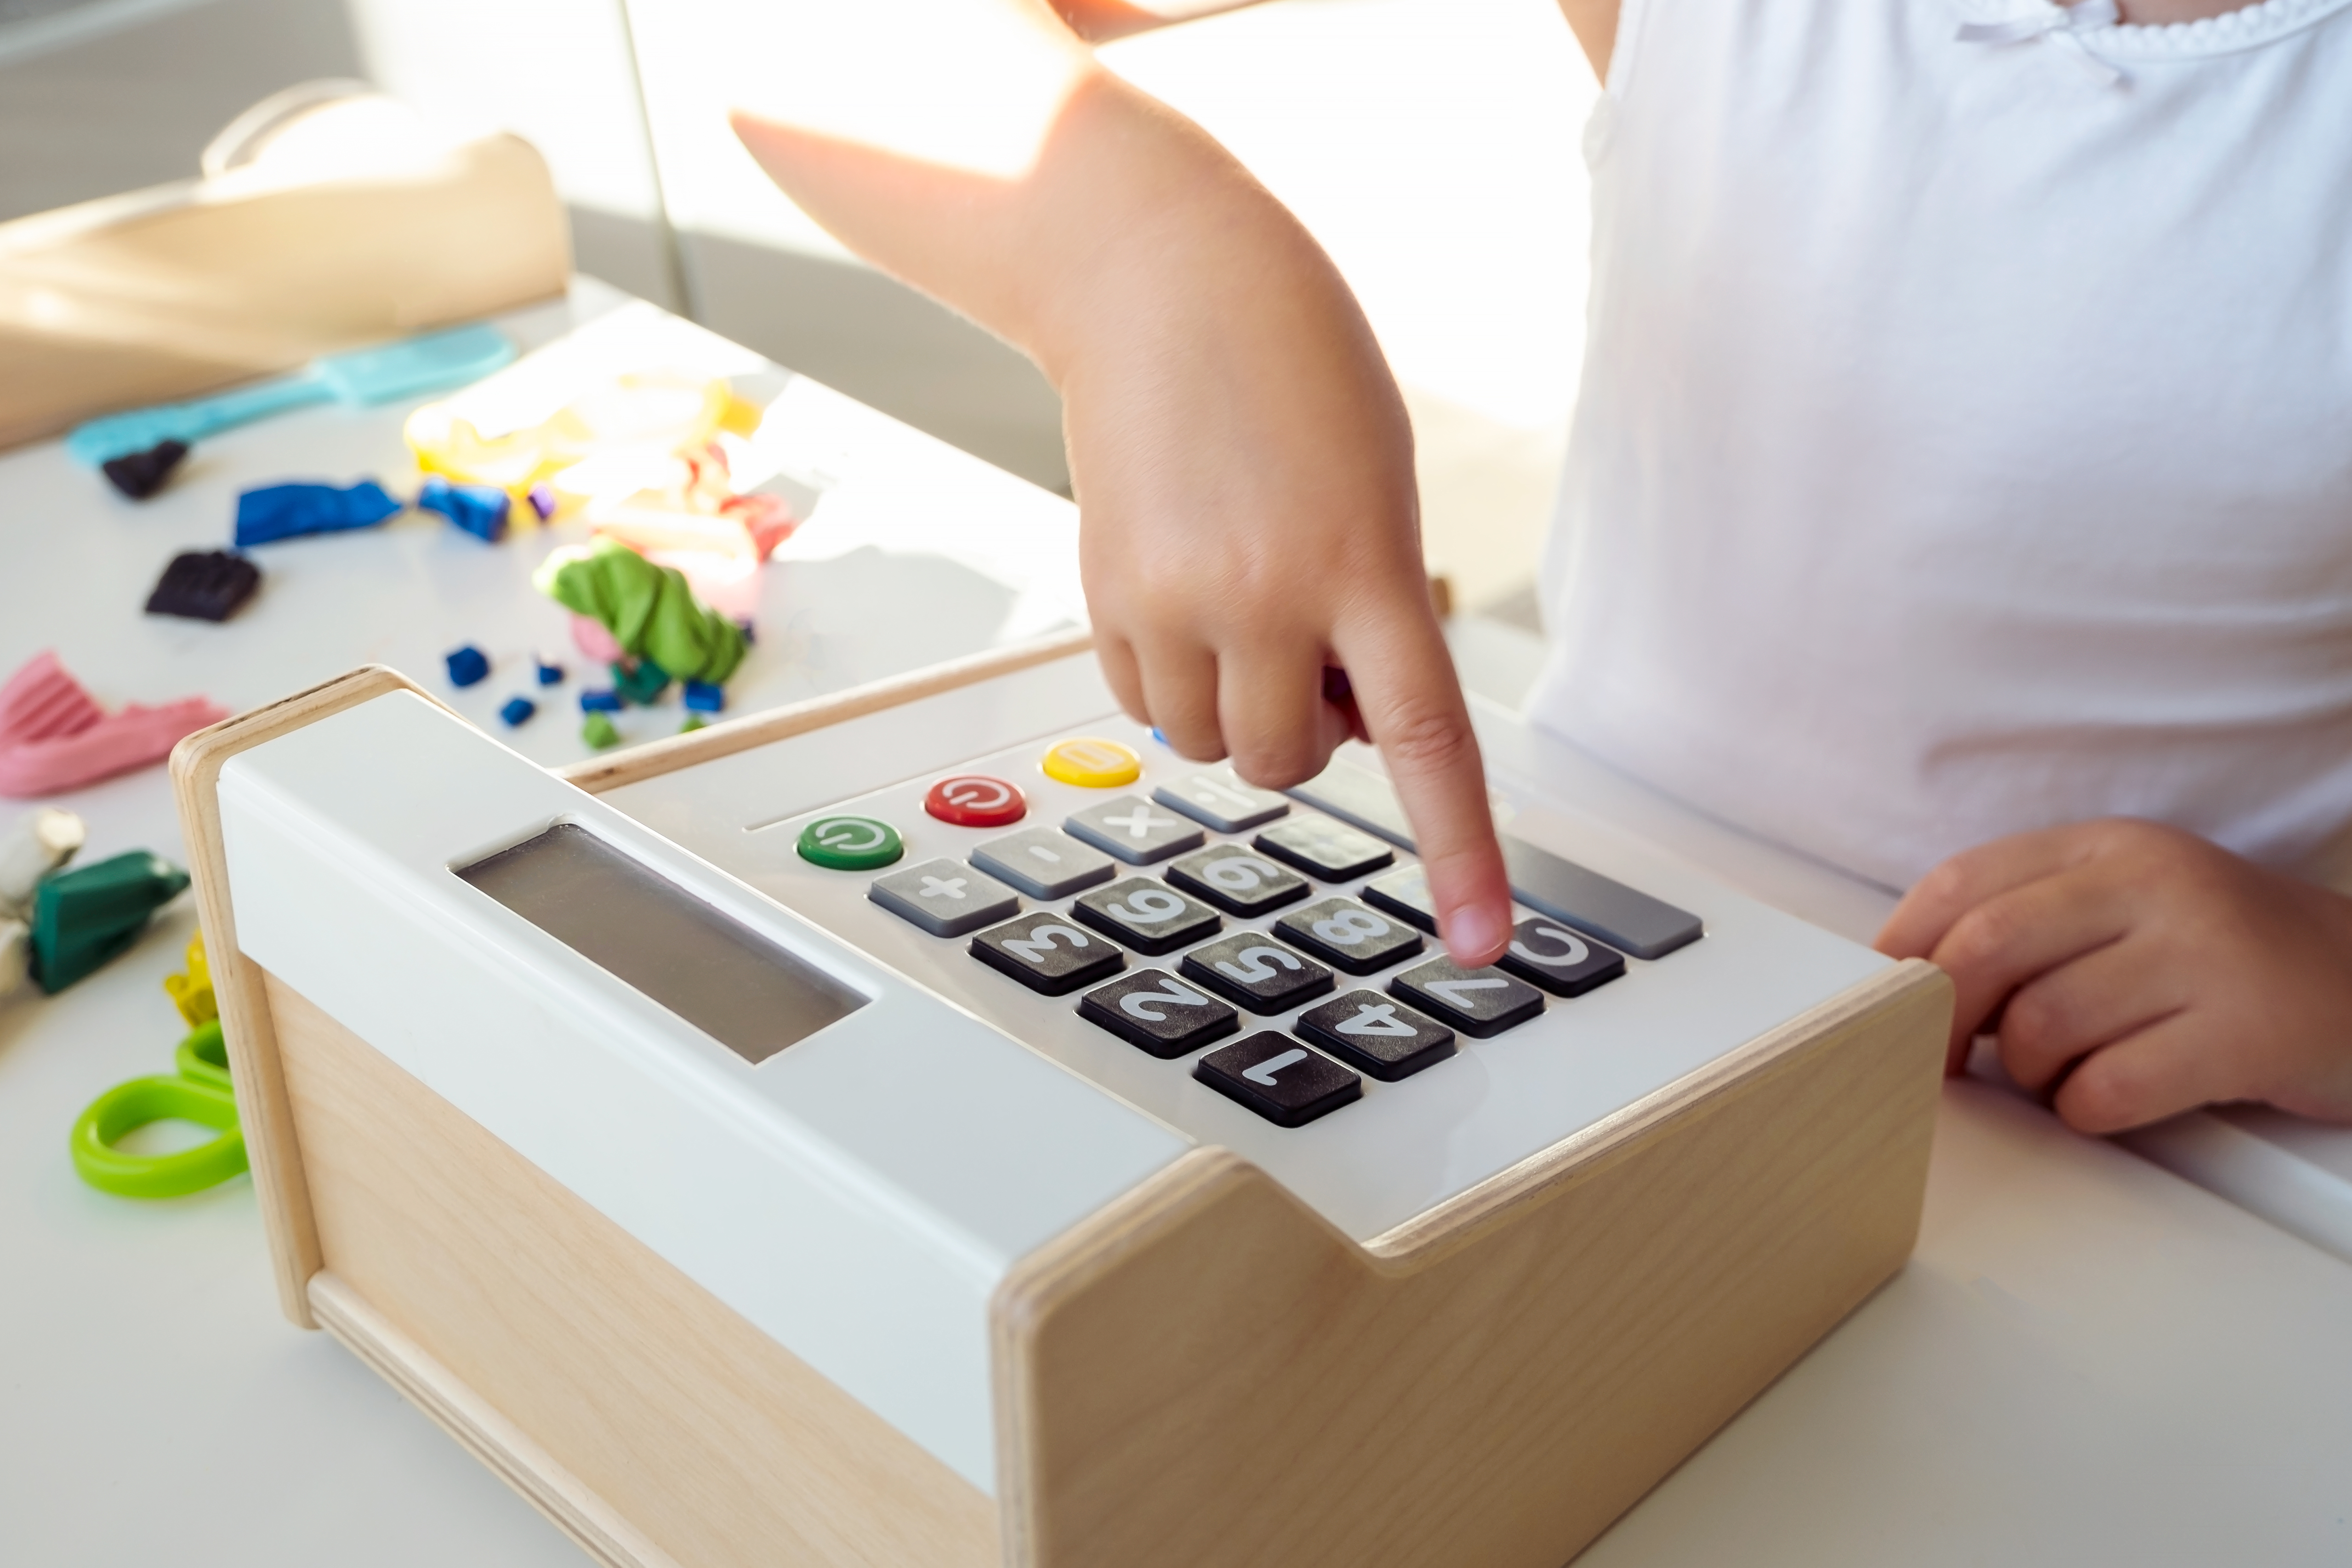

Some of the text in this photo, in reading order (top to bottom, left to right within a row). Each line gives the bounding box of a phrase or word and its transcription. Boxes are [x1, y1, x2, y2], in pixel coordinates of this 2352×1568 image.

[1000, 924, 1089, 964] 3
[1312, 909, 1390, 945] 8
[1214, 946, 1303, 984] 5
[1119, 978, 1209, 1022] 2
[1424, 978, 1510, 1009] 7
[1335, 1004, 1418, 1037] 4
[1241, 1049, 1309, 1087] 1
